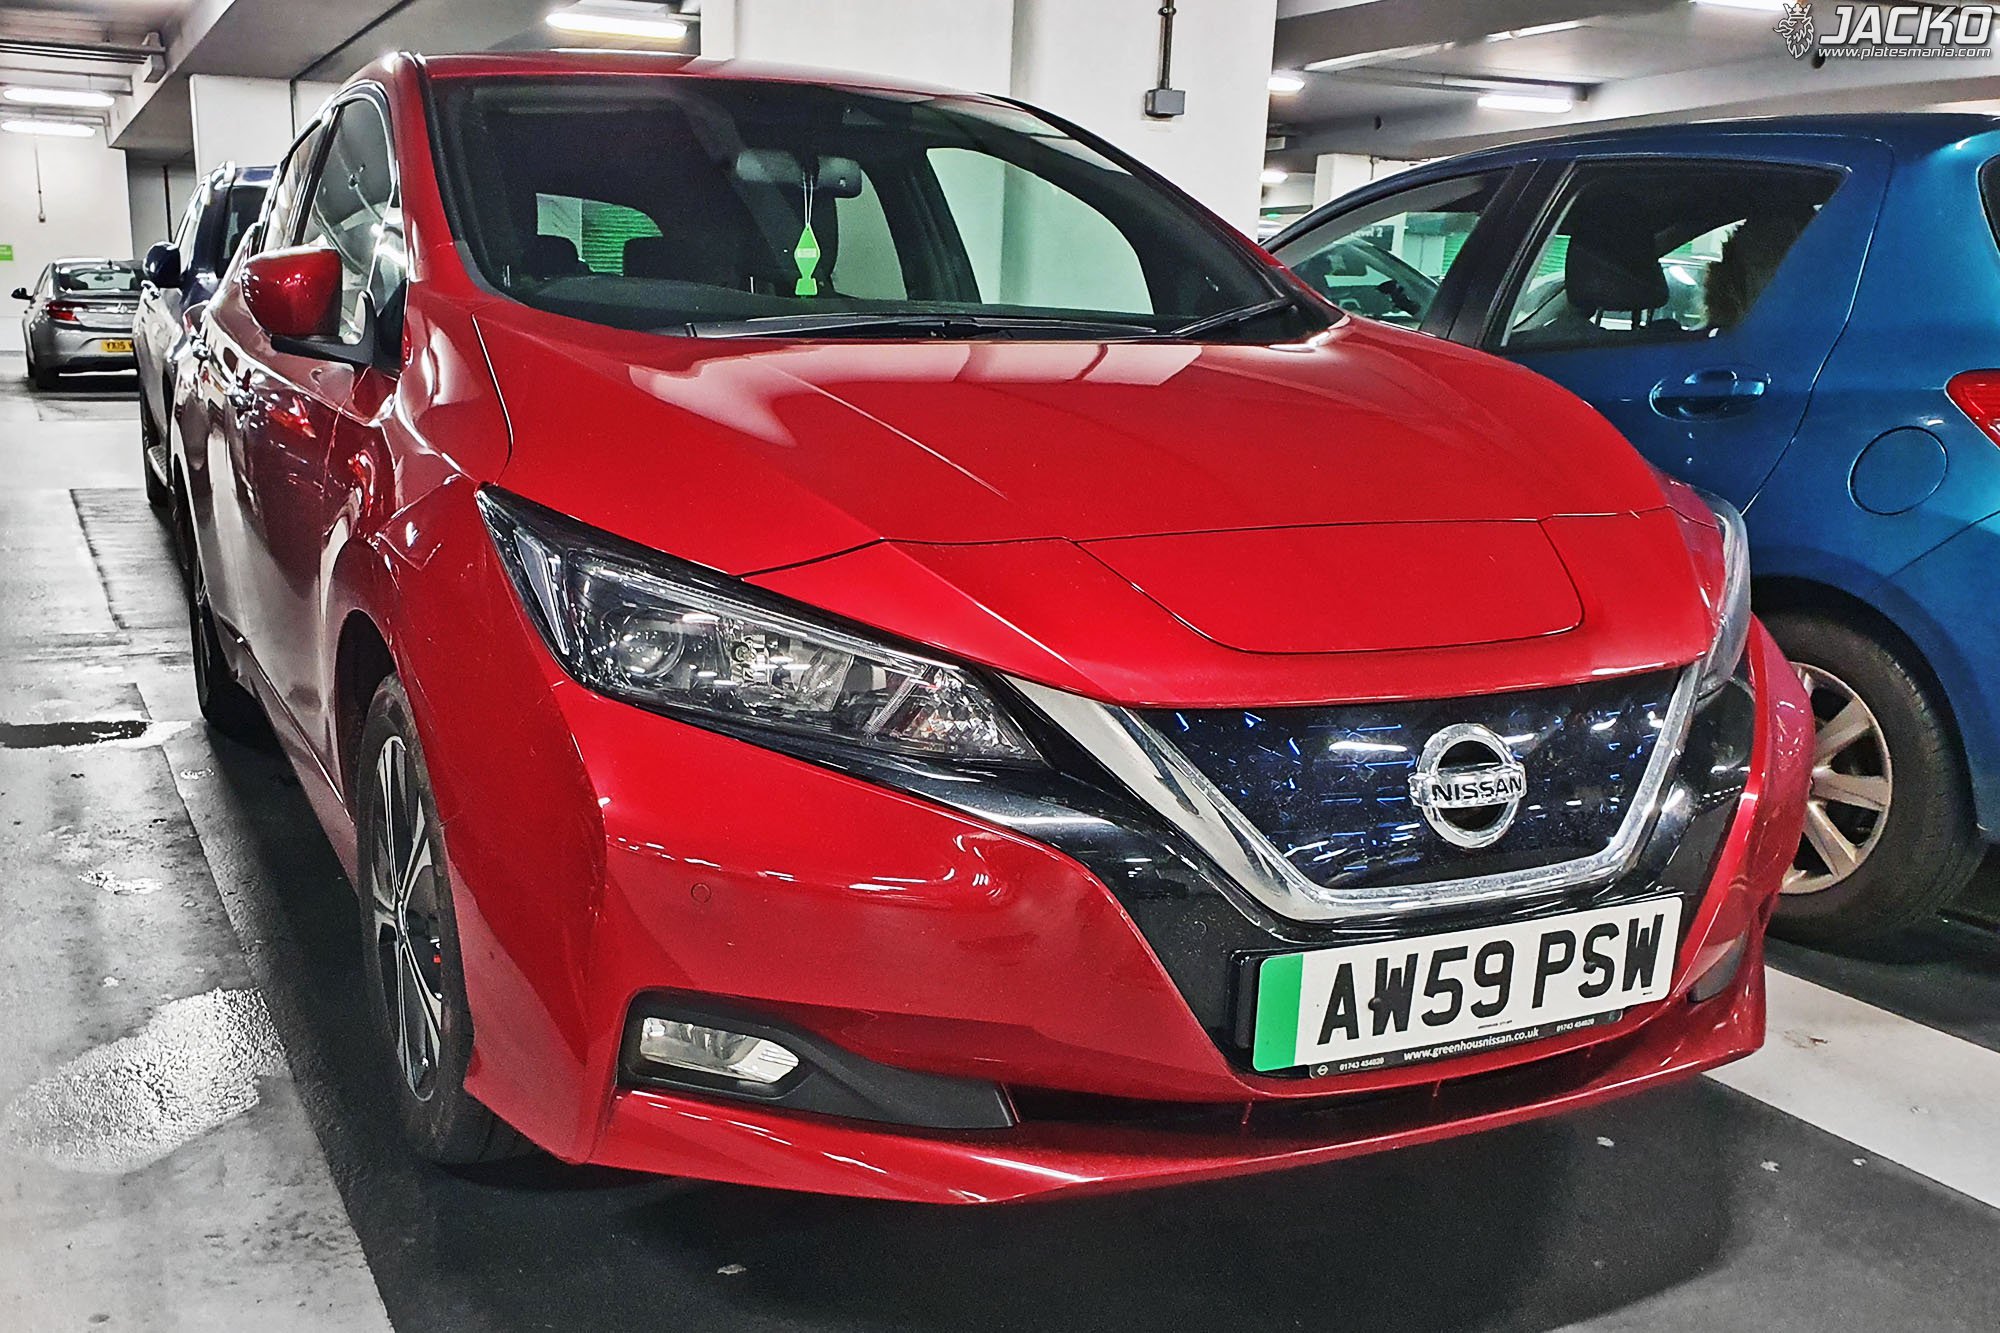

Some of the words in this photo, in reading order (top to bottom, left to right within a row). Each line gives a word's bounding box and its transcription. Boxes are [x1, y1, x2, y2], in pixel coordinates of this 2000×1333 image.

[1431, 775, 1522, 801] NISSAN
[1317, 939, 1515, 1046] AW59
[1532, 914, 1665, 1009] PSW
[1403, 1026, 1540, 1061] www.greenhousnissan.co.uk
